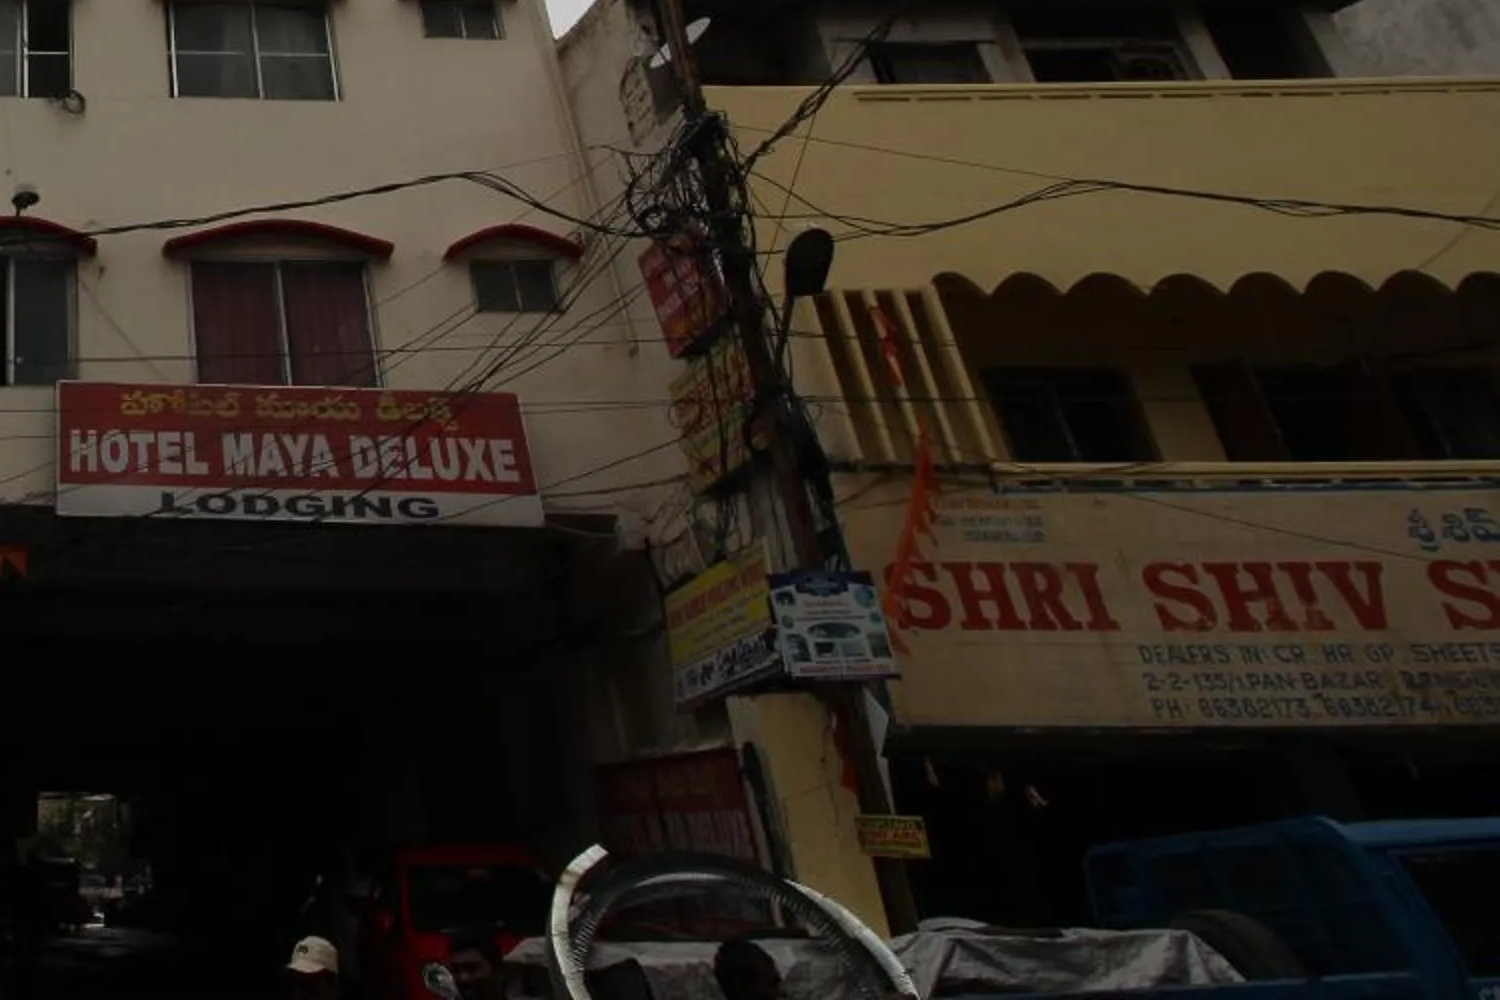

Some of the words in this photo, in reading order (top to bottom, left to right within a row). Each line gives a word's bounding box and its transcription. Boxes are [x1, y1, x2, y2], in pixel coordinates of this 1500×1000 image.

[70, 428, 209, 476] HOTEL
[222, 432, 337, 479] MAYA
[348, 434, 520, 482] DELUXE
[158, 491, 440, 520] LODGING
[884, 560, 1121, 631] SHRI
[1142, 560, 1388, 631] SHIV
[1136, 644, 1231, 664] DEALERS
